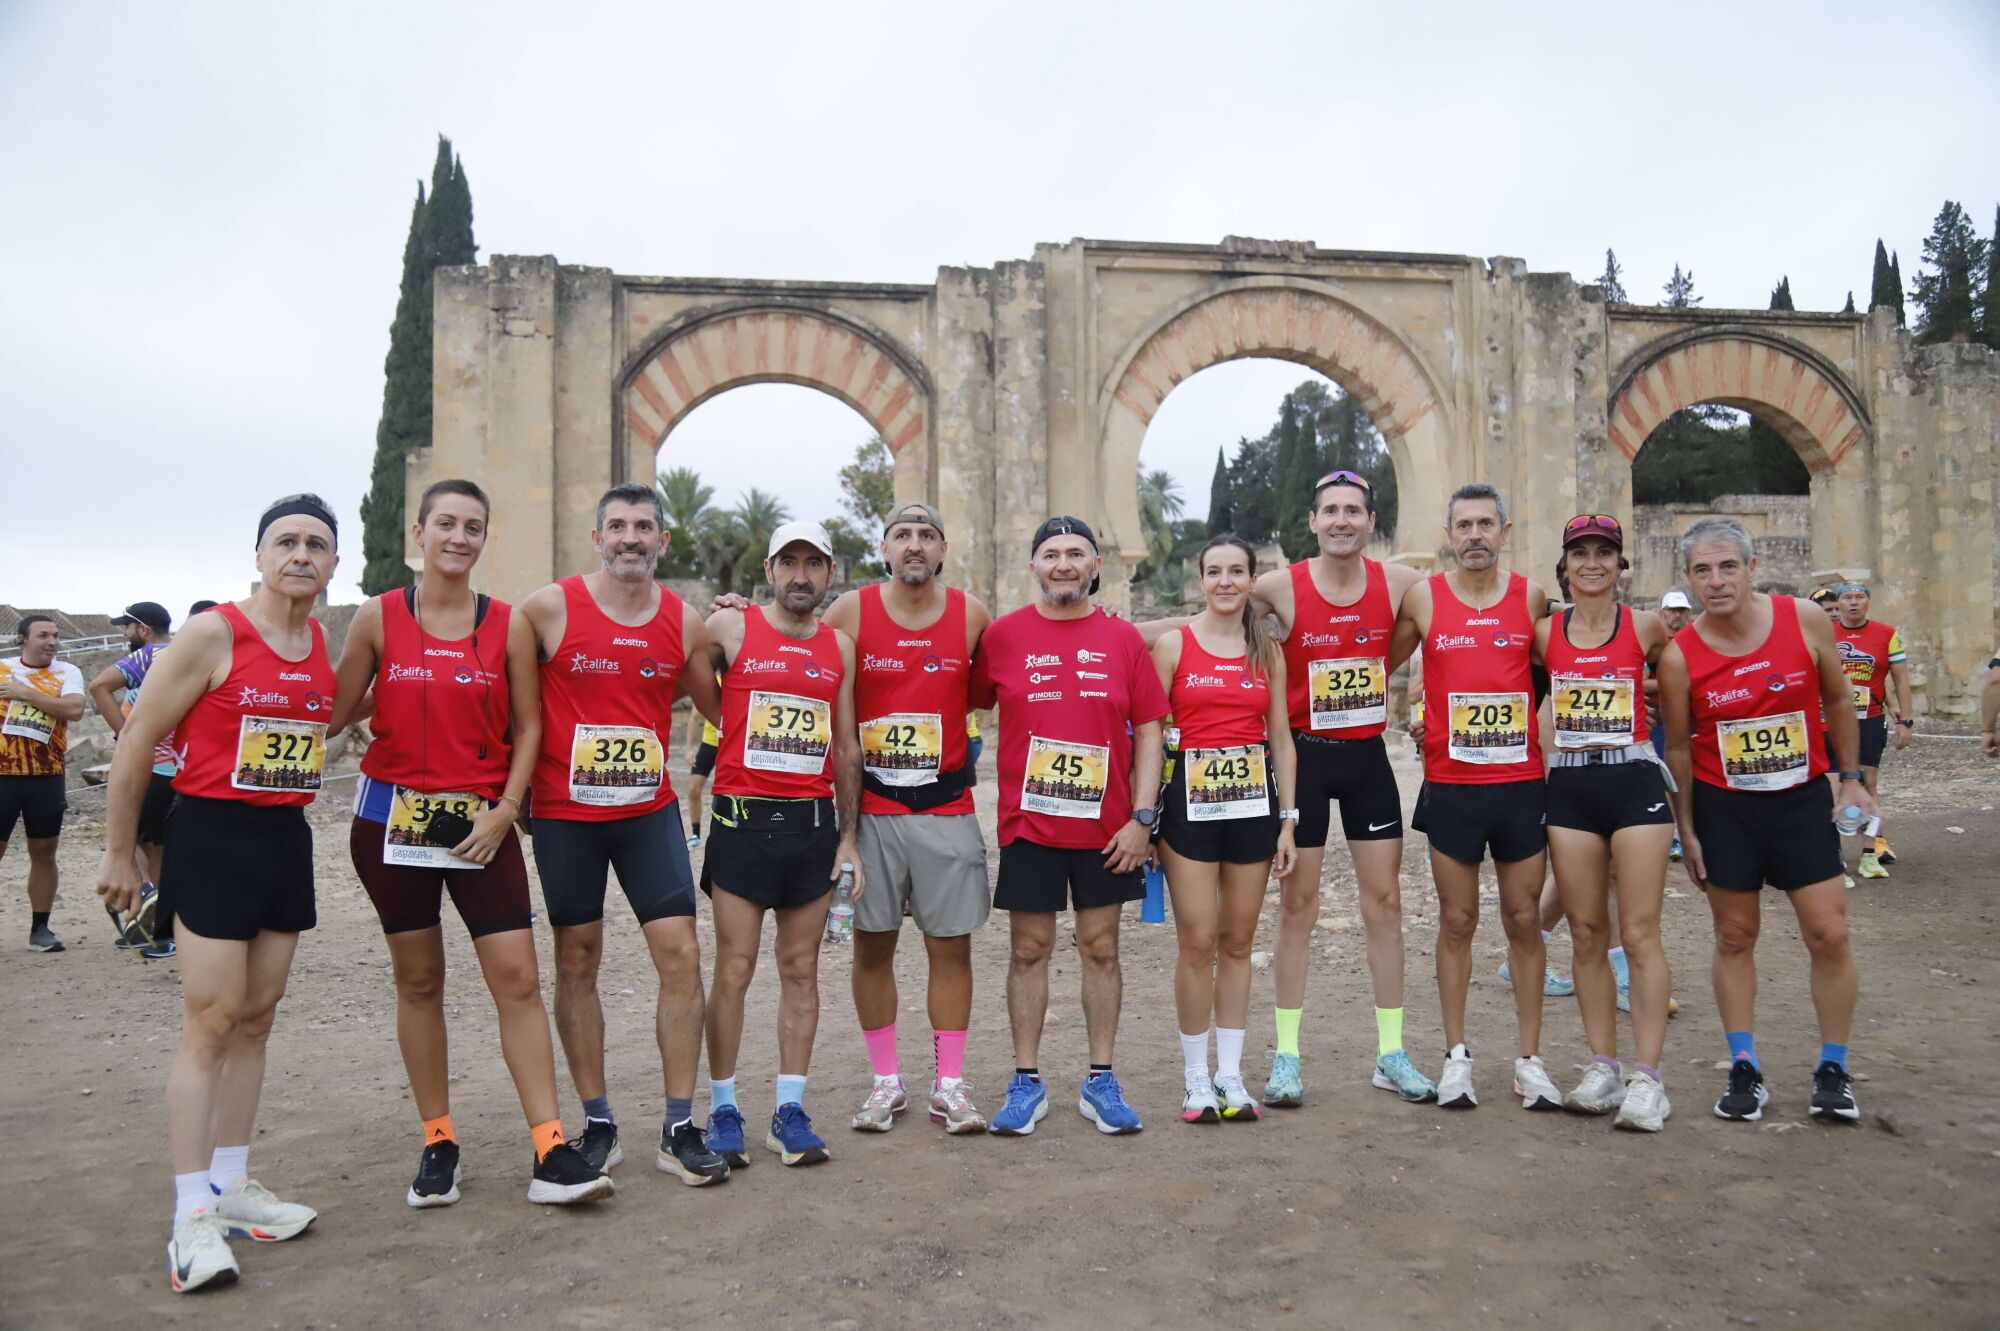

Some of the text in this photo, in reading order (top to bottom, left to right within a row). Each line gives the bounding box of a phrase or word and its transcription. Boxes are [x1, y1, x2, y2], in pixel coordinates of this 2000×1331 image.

[1310, 633, 1339, 644] califas
[1444, 635, 1475, 646] califas
[582, 658, 619, 670] califas
[752, 660, 786, 670] califas
[871, 657, 904, 668] califas
[1033, 654, 1060, 665] califas
[396, 666, 433, 677] califas
[1194, 675, 1224, 685] califas
[1328, 667, 1371, 691] 325
[253, 692, 289, 705] califas
[755, 696, 770, 706] 39
[1036, 691, 1062, 699] IMDECO
[1453, 696, 1467, 706] 39
[1568, 689, 1616, 711] 247
[1715, 688, 1749, 703] califas
[768, 705, 816, 733] 379
[1467, 704, 1513, 726] 203
[248, 721, 266, 734] 39
[581, 730, 596, 740] 39
[885, 725, 917, 747] 42
[1739, 726, 1791, 753] 194
[264, 733, 314, 762] 327
[594, 738, 646, 763] 326
[1033, 742, 1046, 753] 39
[1051, 753, 1084, 777] 45
[1204, 757, 1250, 781] 443
